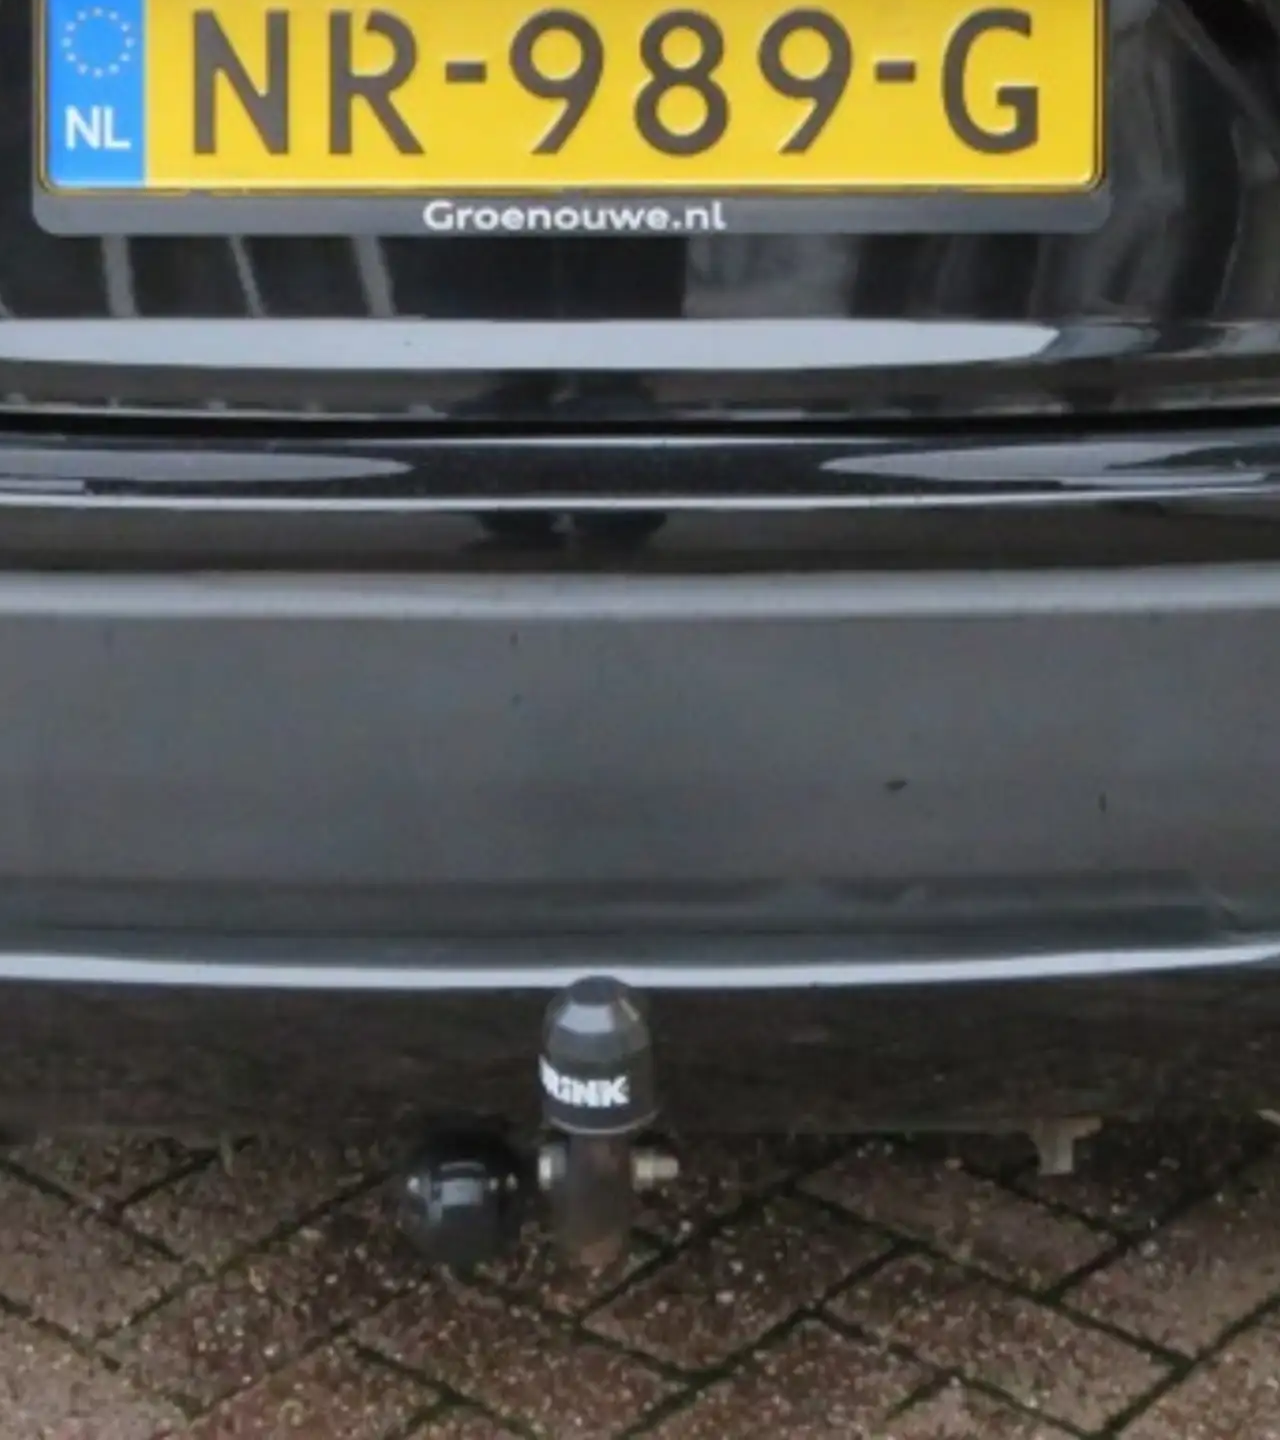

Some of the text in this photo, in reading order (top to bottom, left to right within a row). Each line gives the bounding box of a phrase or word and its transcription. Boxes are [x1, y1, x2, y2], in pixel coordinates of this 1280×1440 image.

[64, 8, 1039, 157] NL NR-989-G
[422, 199, 727, 232] Groenouwe.nl
